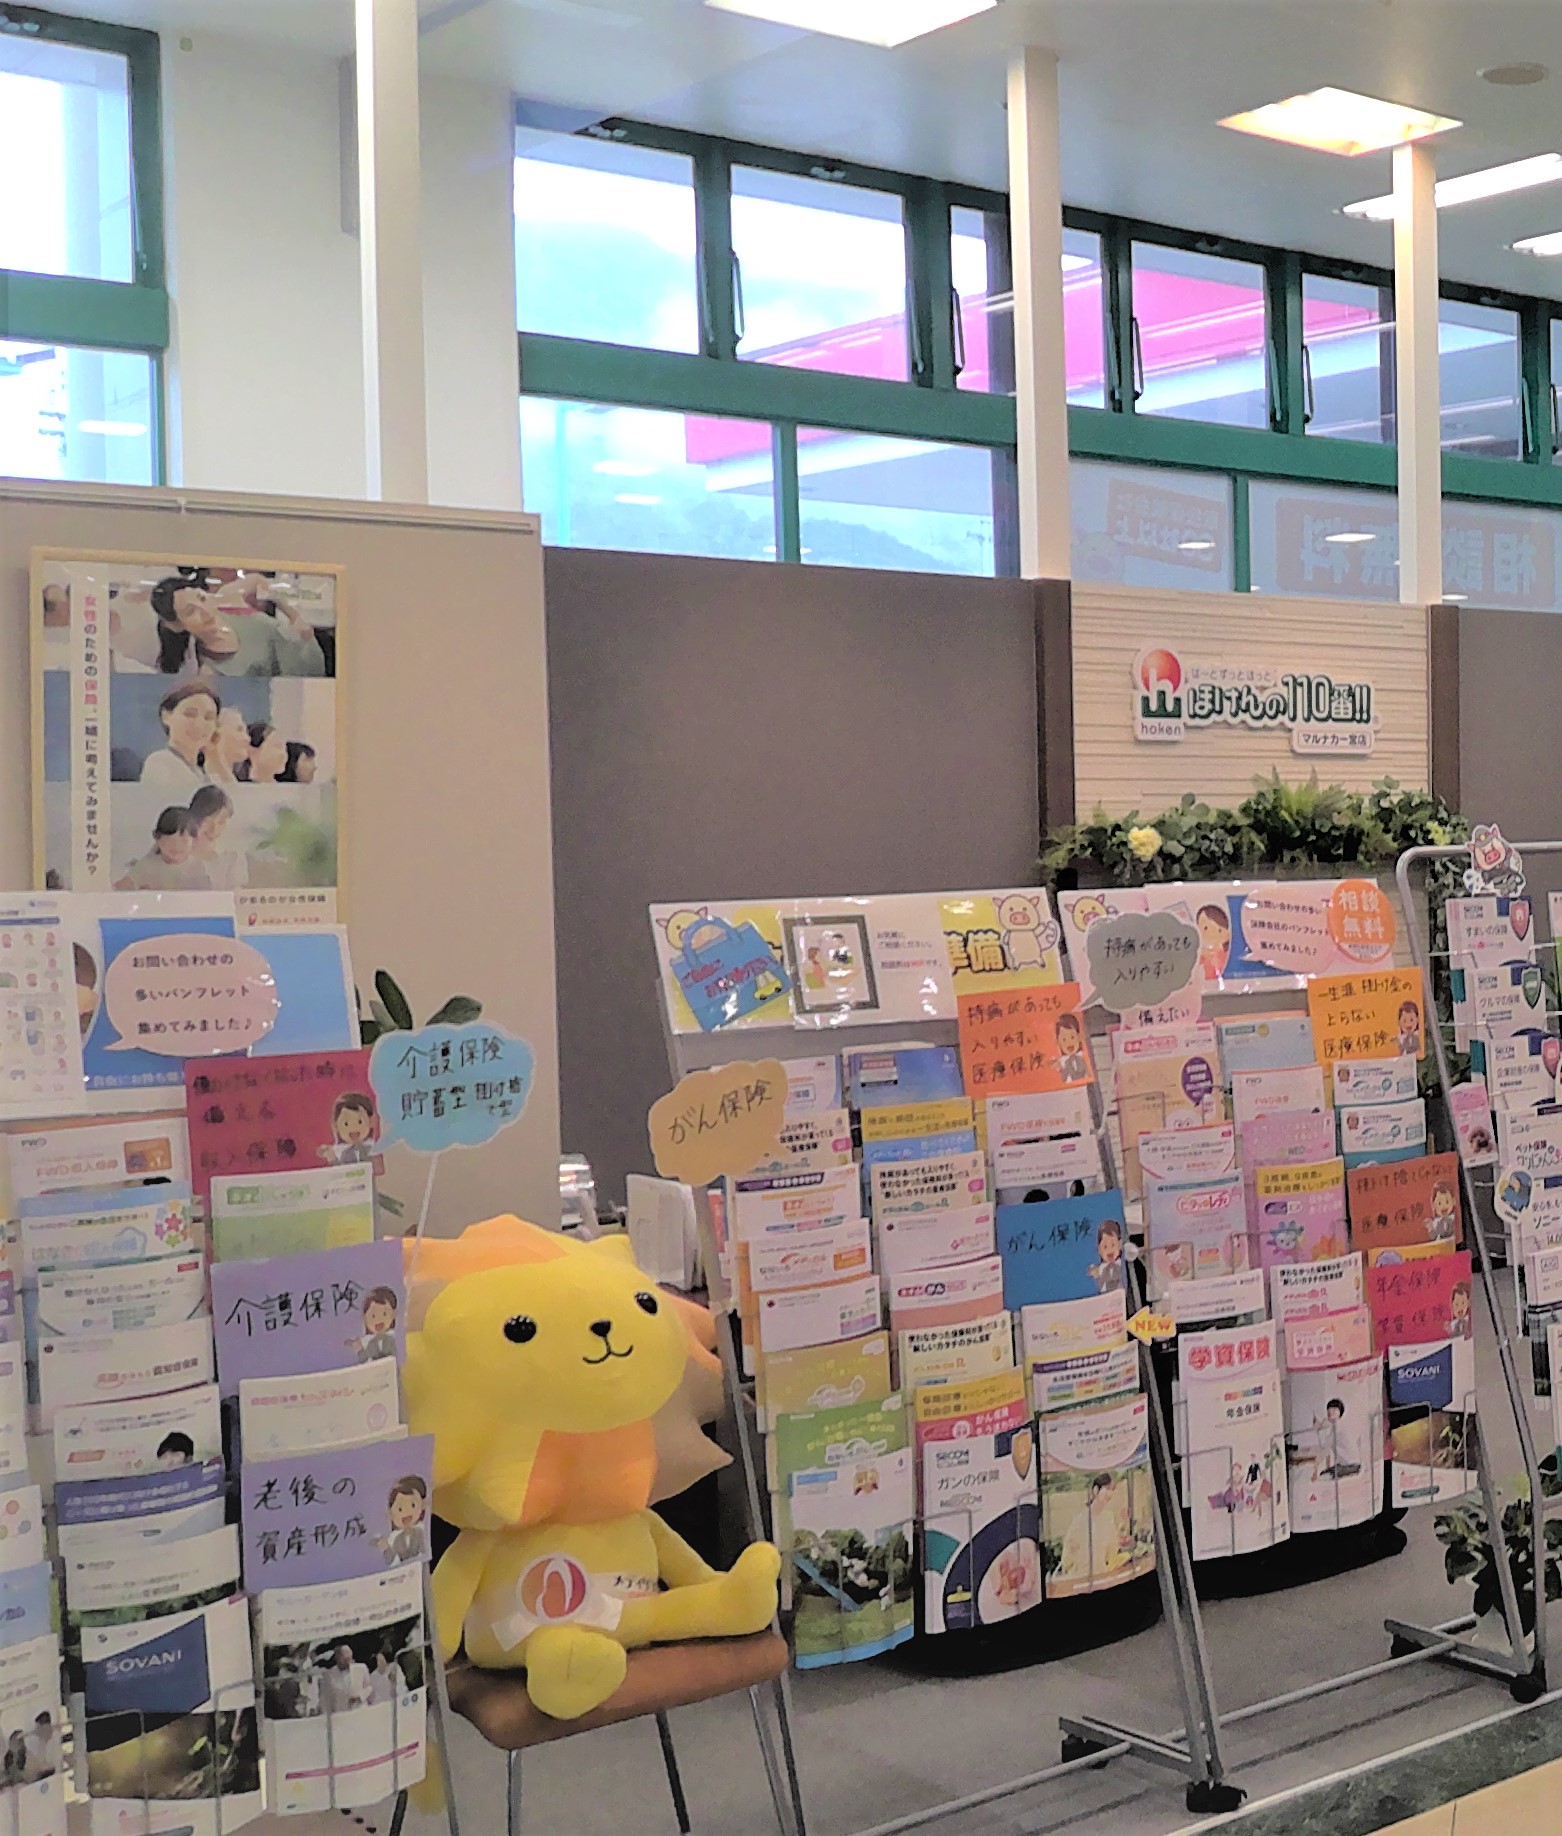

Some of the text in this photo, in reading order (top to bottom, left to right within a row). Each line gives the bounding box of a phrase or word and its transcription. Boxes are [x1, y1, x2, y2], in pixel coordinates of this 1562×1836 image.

[1186, 675, 1373, 725] ほけんの110番!!
[1140, 722, 1182, 736] hoken
[1339, 889, 1380, 912] 相談
[1343, 914, 1384, 939] 無料
[1466, 924, 1508, 937] すまいの保険
[1103, 935, 1193, 958] 持病があっても
[132, 953, 234, 969] お問い合わせの
[1114, 963, 1175, 983] 入りやすい
[135, 986, 250, 1002] 多いパンフレット
[1317, 975, 1413, 1002] 一生涯 掛け金の
[1479, 994, 1521, 1009] クルマの保険
[967, 995, 1062, 1026] 持病があっても
[1138, 1007, 1191, 1026] 備えたい
[1326, 1008, 1376, 1026] 上らない
[971, 1033, 1038, 1053] 入りやすい
[1323, 1029, 1390, 1060] 医療保険
[397, 1036, 505, 1080] 介護保険
[971, 1052, 1046, 1085] 医療保険
[401, 1084, 467, 1121] 貯蓄型
[667, 1078, 773, 1145] がん保険
[1361, 1201, 1425, 1233] 医療保険
[1007, 1216, 1092, 1254] がん保険
[1376, 1267, 1441, 1300] 年金保険
[225, 1280, 364, 1337] 介護保険
[1134, 1316, 1172, 1333] NEW
[1187, 1335, 1271, 1372] 学資保険
[1397, 1365, 1440, 1379] SOVANI
[936, 1449, 969, 1460] SECOM
[253, 1474, 357, 1510] 老後の
[937, 1469, 1000, 1491] ガンの保険
[255, 1513, 367, 1564] 資産形成
[105, 1649, 182, 1676] SOVANI
